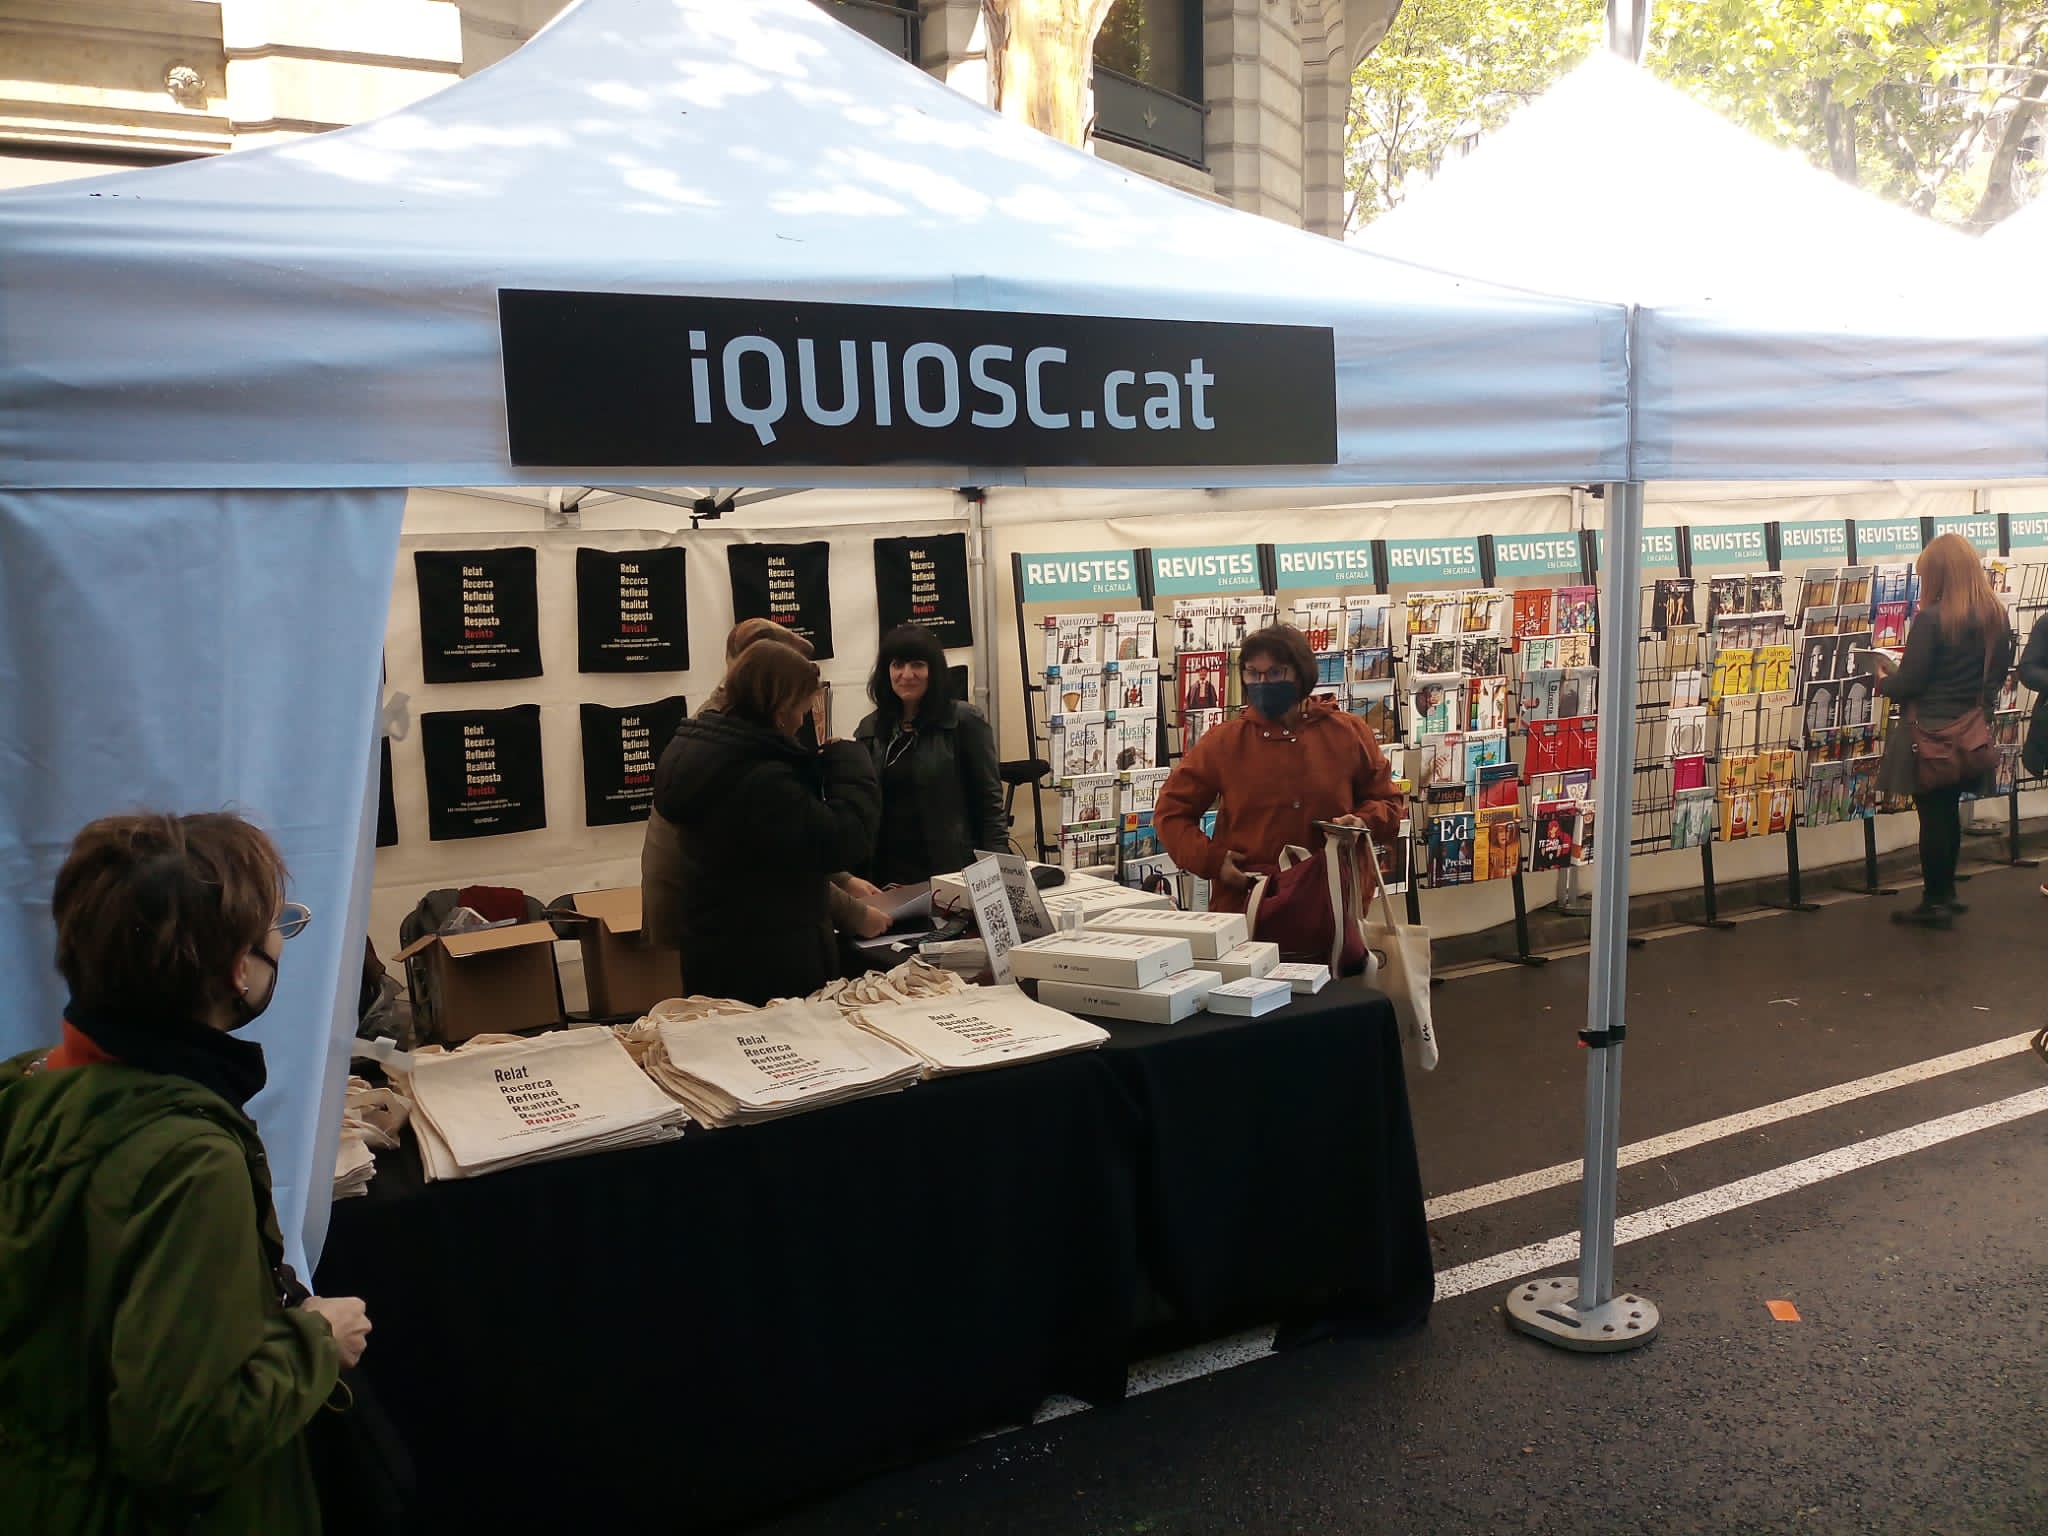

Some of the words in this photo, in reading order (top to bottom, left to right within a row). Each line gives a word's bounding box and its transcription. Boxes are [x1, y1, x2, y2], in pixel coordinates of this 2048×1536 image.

[688, 329, 1216, 447] iQUIOSC.cat
[1784, 527, 1844, 546] REVISTES
[1858, 525, 1919, 544] REVISTES
[1693, 531, 1762, 552] REVISTES
[1391, 545, 1475, 567] REVISTES
[1497, 540, 1577, 562] REVISTES
[1157, 553, 1254, 578] REVISTES
[1280, 549, 1368, 573] REVISTES
[463, 566, 483, 576] Relat
[620, 563, 639, 574] Relat
[768, 568, 795, 578] Recerca
[1027, 559, 1130, 585] REVISTES
[1443, 567, 1451, 575] EN
[1452, 566, 1476, 575] CATALÀ
[620, 575, 648, 585] Recerca
[1218, 577, 1228, 586] EN
[1229, 575, 1255, 585] CATALÀ
[1336, 572, 1345, 580] EN
[1346, 570, 1369, 579] CATALÀ
[463, 579, 494, 589] Recerca
[1093, 584, 1104, 592] EN
[1105, 583, 1132, 592] CATALÀ
[463, 591, 494, 601] Reflexió
[620, 587, 648, 597] Reflexió
[464, 604, 494, 614] Realitat
[621, 599, 648, 609] Realitat
[1229, 604, 1275, 615] caramella
[621, 611, 653, 623] Resposta
[1175, 607, 1222, 618] caramella
[464, 616, 500, 628] Resposta
[1058, 638, 1089, 648] BALLAR
[622, 717, 640, 727] Relat
[464, 725, 484, 736] Relat
[464, 738, 495, 748] Recerca
[466, 761, 496, 772] Realitat
[624, 762, 656, 773] Resposta
[467, 773, 501, 785] Resposta
[1440, 816, 1469, 842] Ed
[736, 1034, 768, 1047] Relat
[744, 1043, 792, 1057] Recerca
[751, 1052, 798, 1065] Reflexió
[494, 1065, 529, 1083] Relat
[499, 1079, 553, 1095] Recerca
[506, 1089, 560, 1105] Reflexió
[512, 1097, 566, 1113] Realitat
[519, 1102, 581, 1120] Resposta
[525, 1112, 577, 1126] Revista
